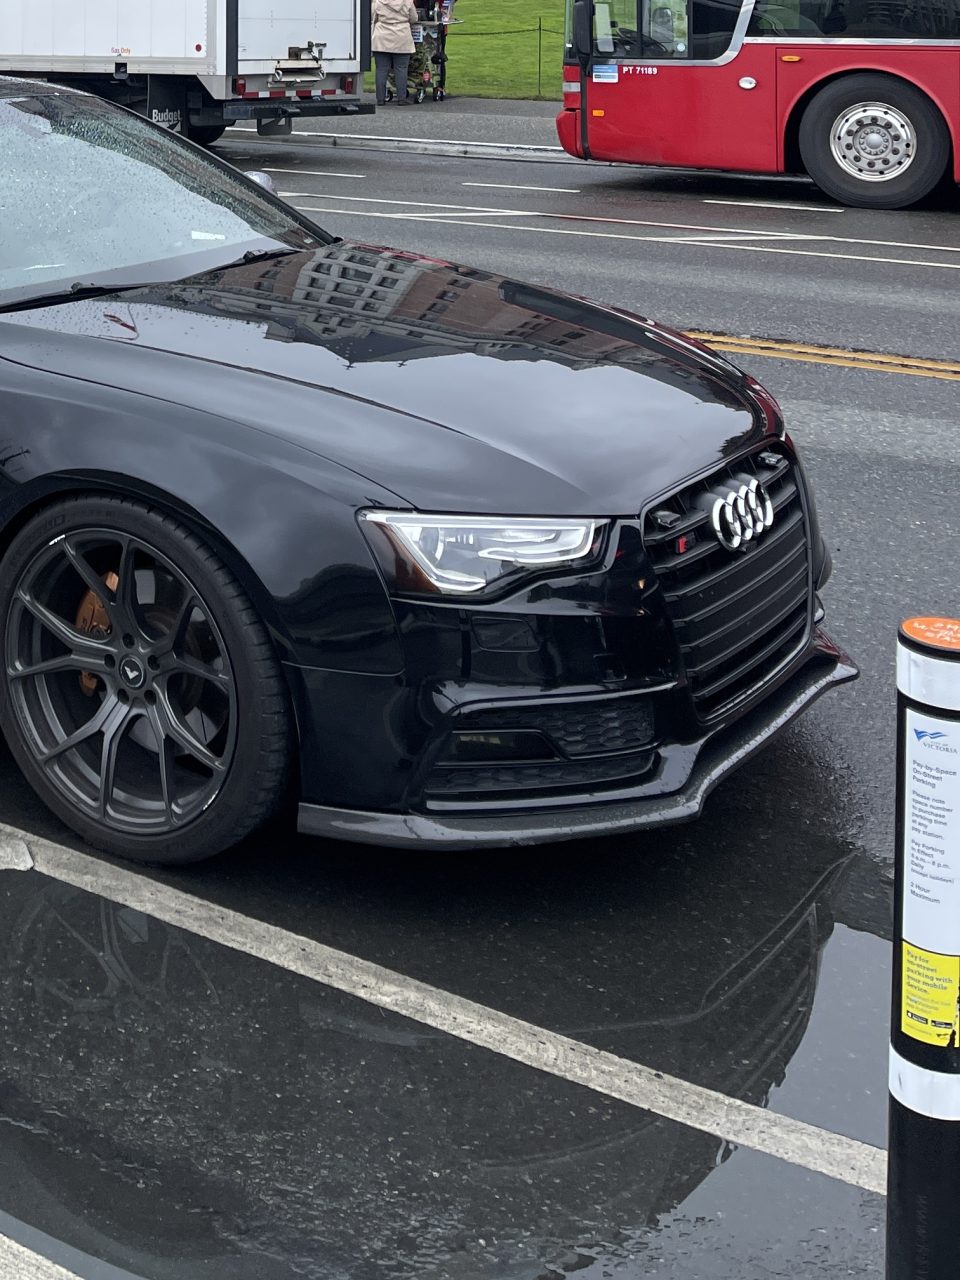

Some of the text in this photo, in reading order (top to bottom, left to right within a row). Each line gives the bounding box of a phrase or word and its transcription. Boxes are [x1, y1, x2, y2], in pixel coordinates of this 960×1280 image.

[622, 66, 634, 74] PT
[635, 66, 658, 75] 71189
[152, 108, 181, 125] Budget
[923, 742, 958, 754] VICTORIA
[912, 759, 957, 776] Pay-by-Space
[912, 767, 943, 782] On-Street
[912, 775, 936, 789] Parking
[910, 888, 941, 904] Maximum
